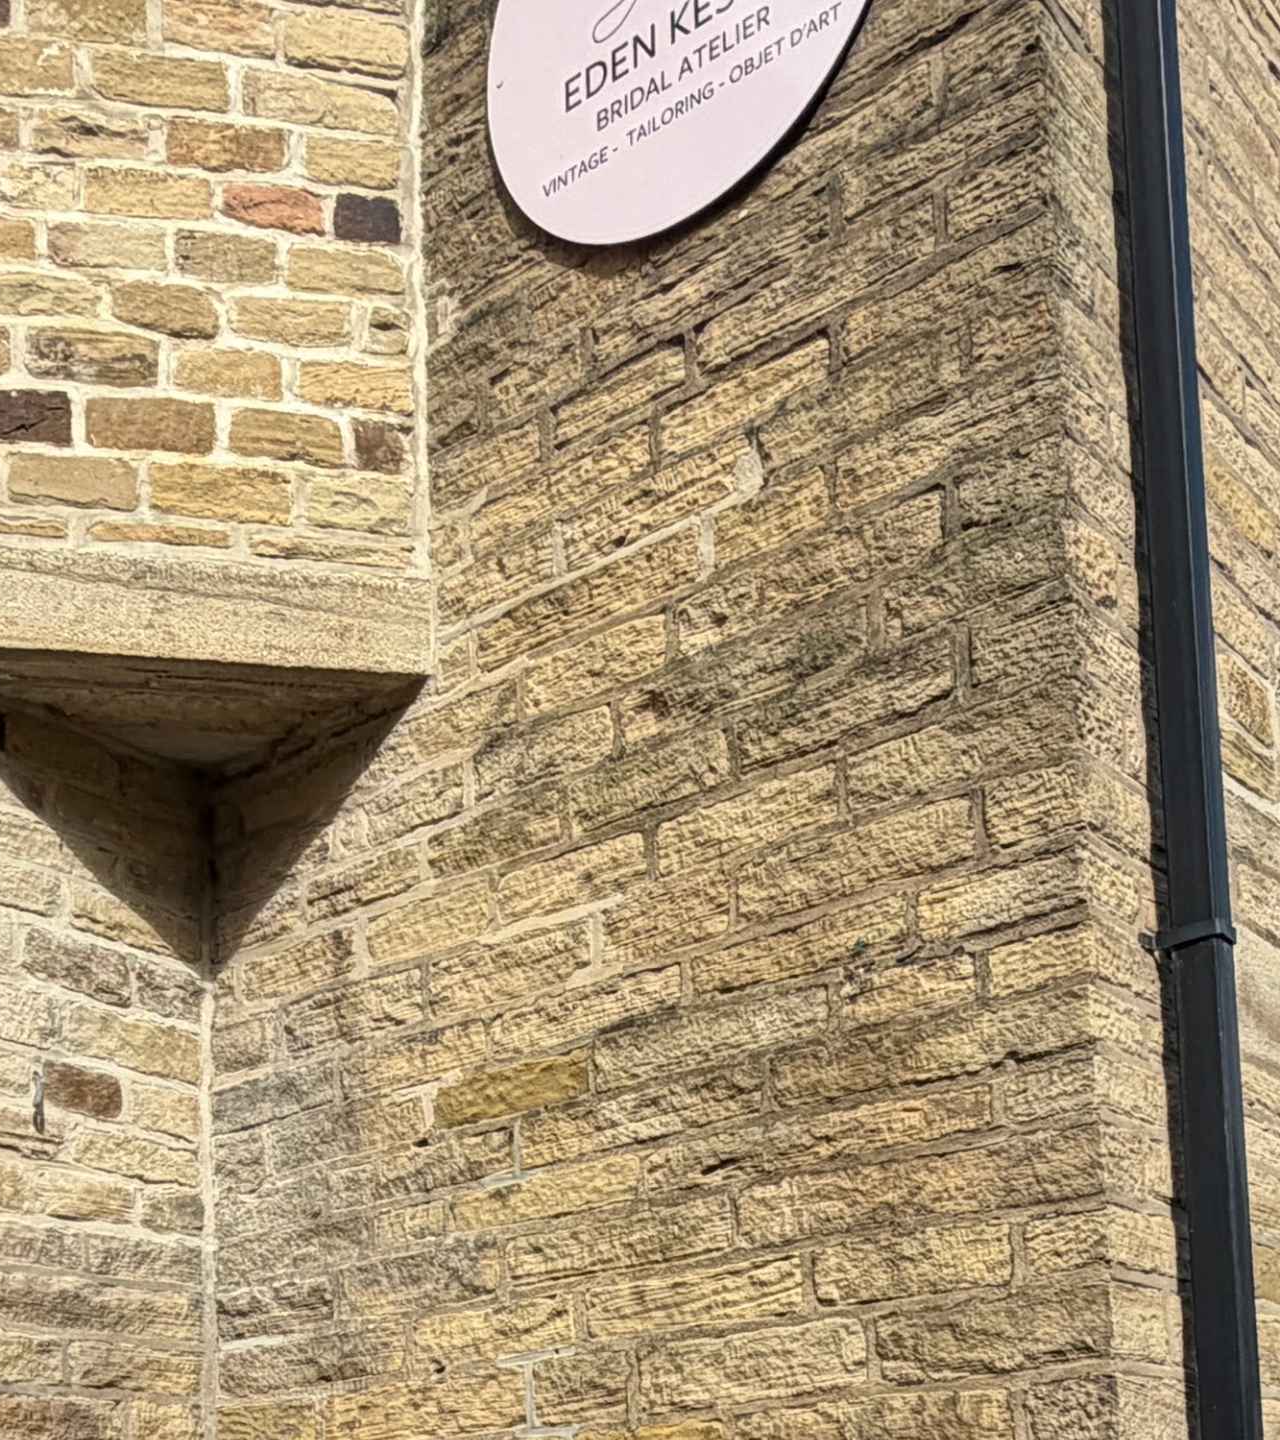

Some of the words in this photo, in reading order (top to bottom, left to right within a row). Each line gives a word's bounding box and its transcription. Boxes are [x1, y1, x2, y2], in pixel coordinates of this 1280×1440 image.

[542, 145, 609, 198] VINTAGE
[625, 80, 715, 147] TAILORING
[728, 36, 785, 84] OBJET
[789, 2, 842, 49] D'ART
[564, 23, 656, 113] EDEN
[596, 69, 673, 132] BRIDAL
[678, 5, 771, 82] ATELIER
